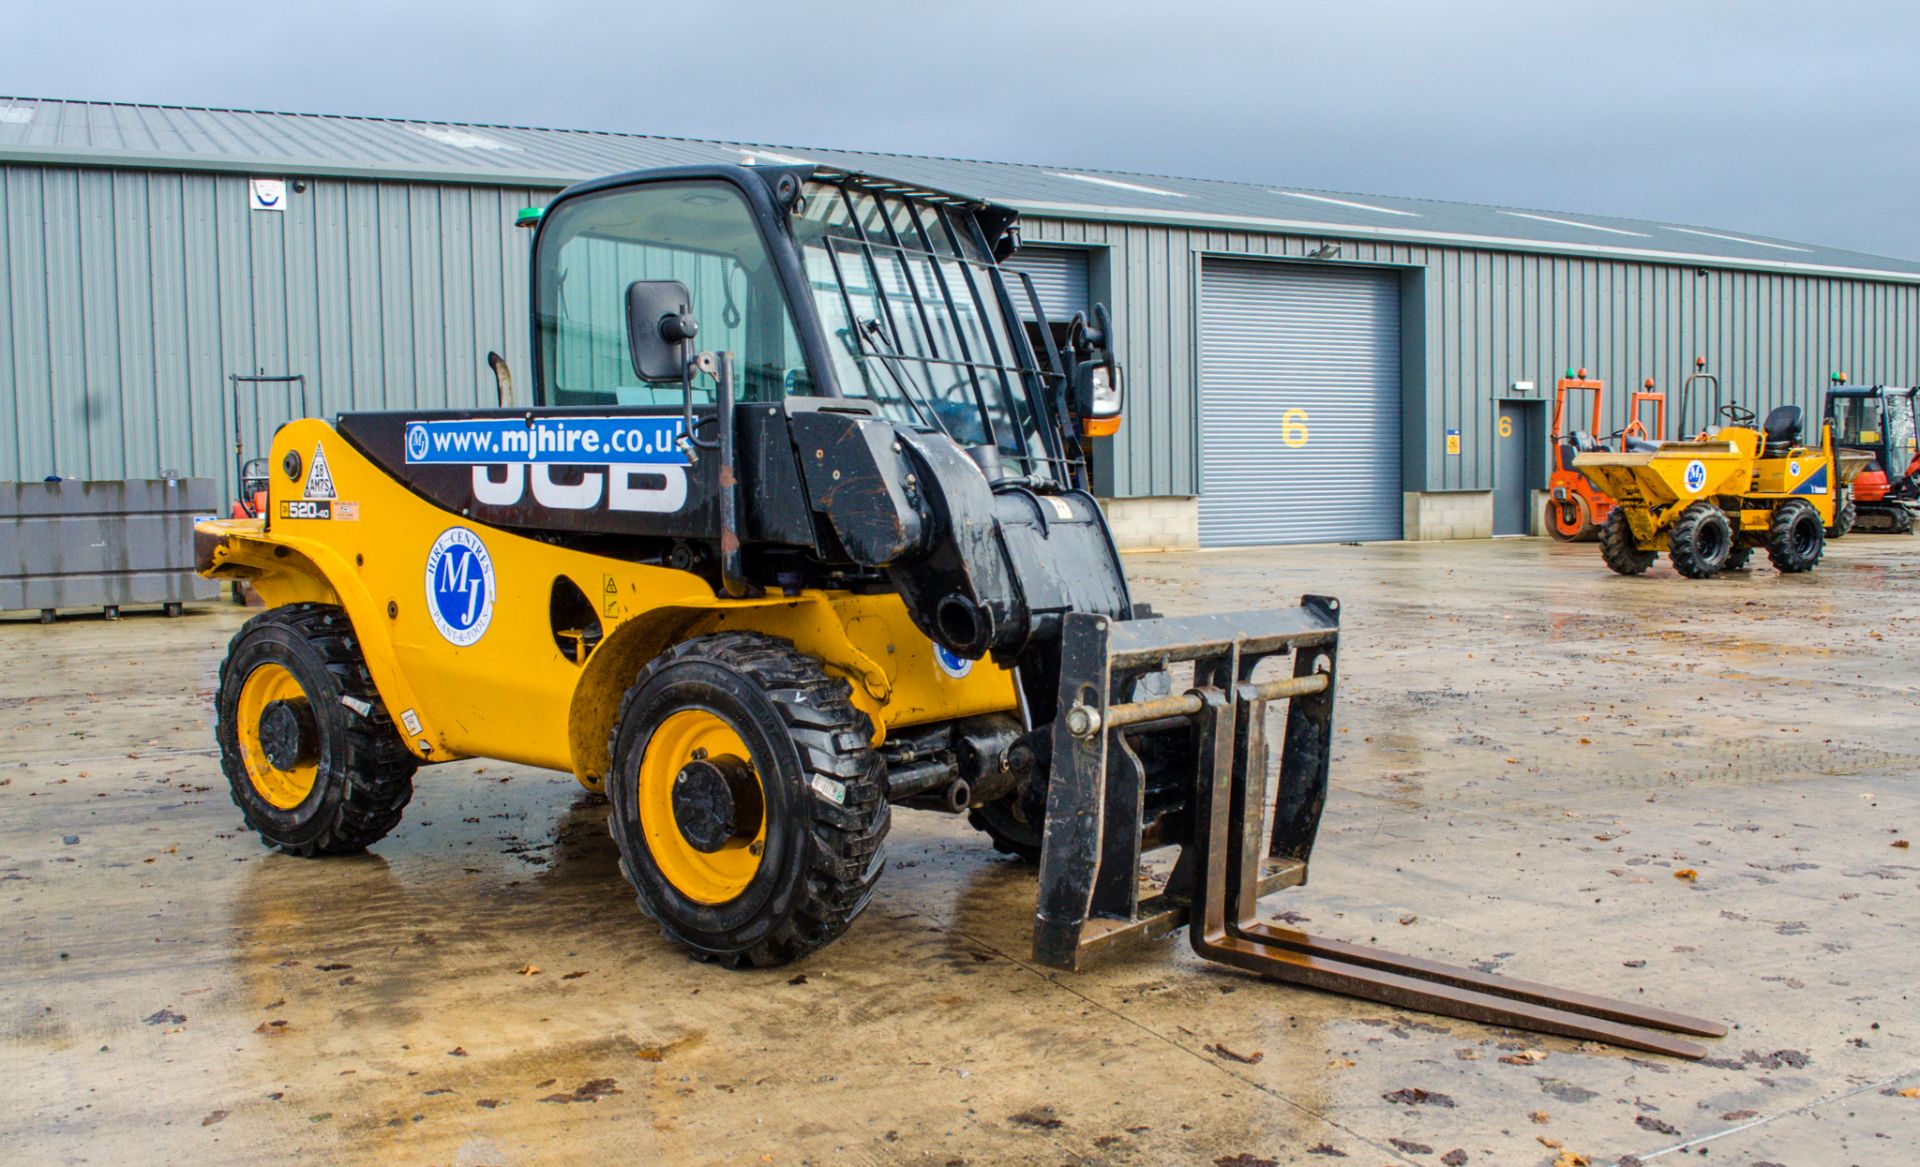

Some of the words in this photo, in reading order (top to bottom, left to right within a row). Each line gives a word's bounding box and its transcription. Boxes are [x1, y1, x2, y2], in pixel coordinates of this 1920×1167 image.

[1282, 408, 1309, 447] 6
[1499, 415, 1512, 437] 6
[439, 551, 482, 626] MJ
